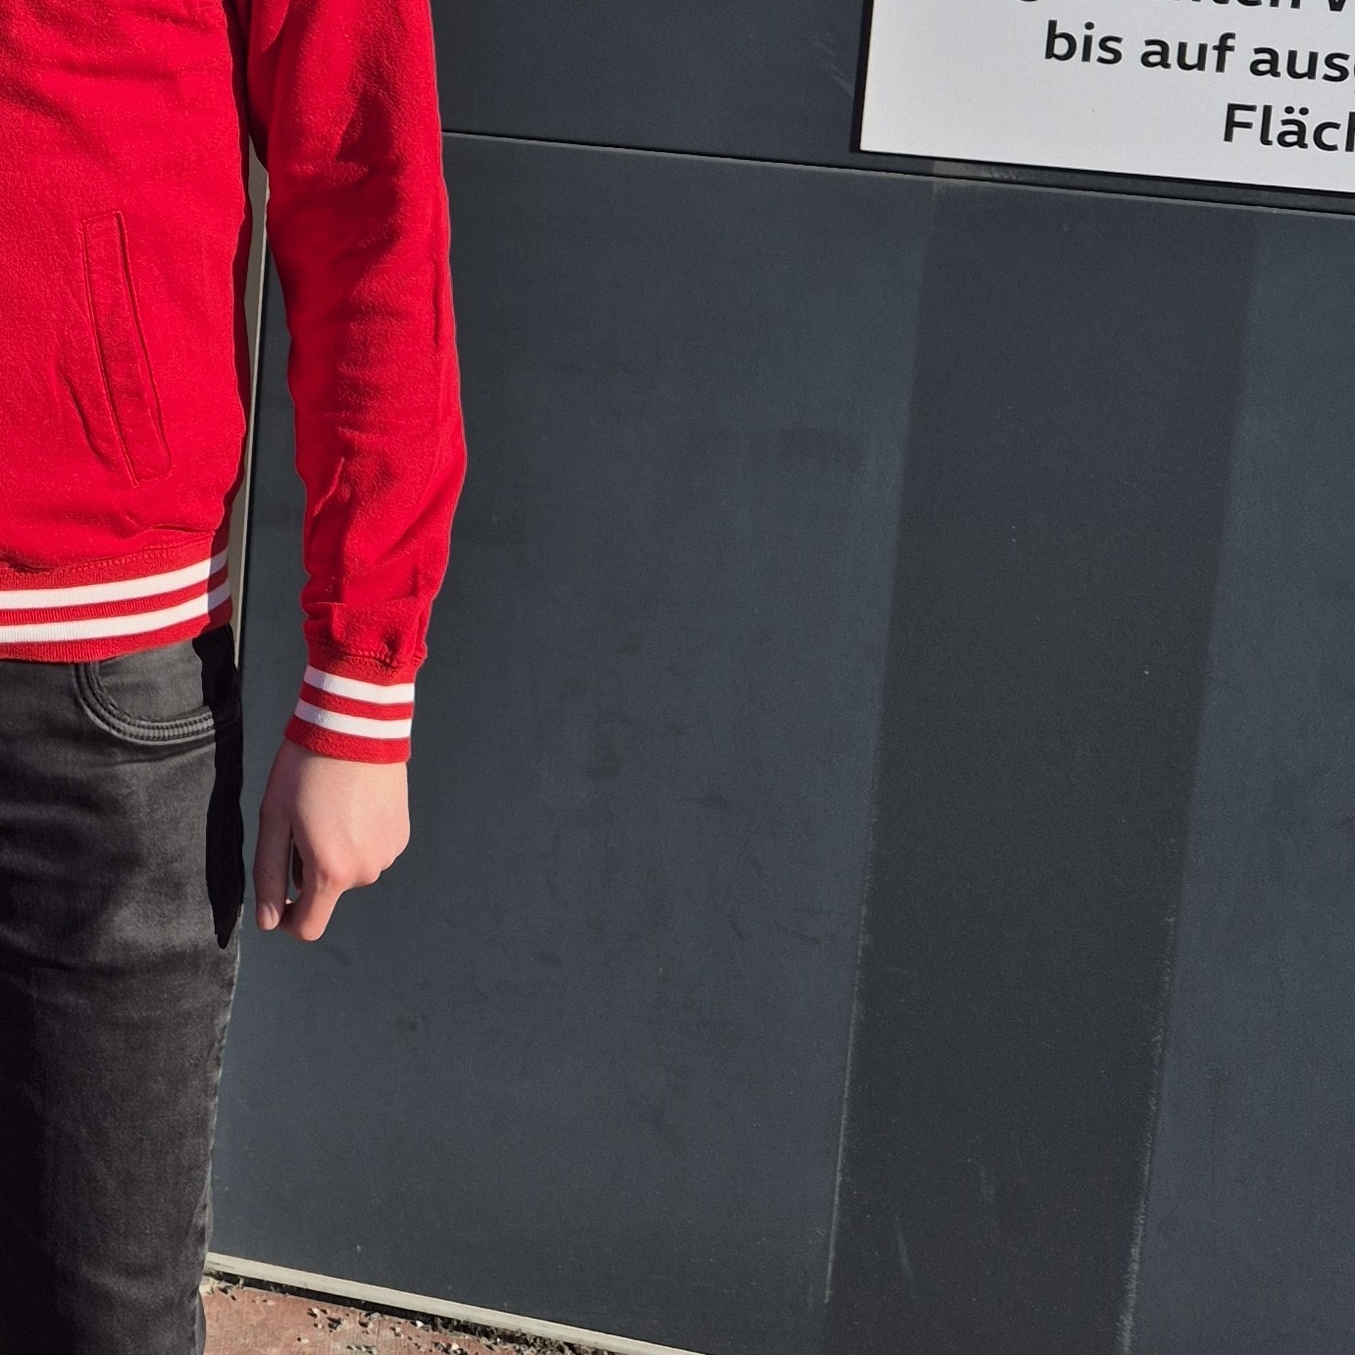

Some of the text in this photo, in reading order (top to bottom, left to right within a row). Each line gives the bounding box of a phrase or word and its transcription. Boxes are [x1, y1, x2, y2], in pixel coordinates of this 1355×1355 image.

[1044, 20, 1355, 85] bis auf aus
